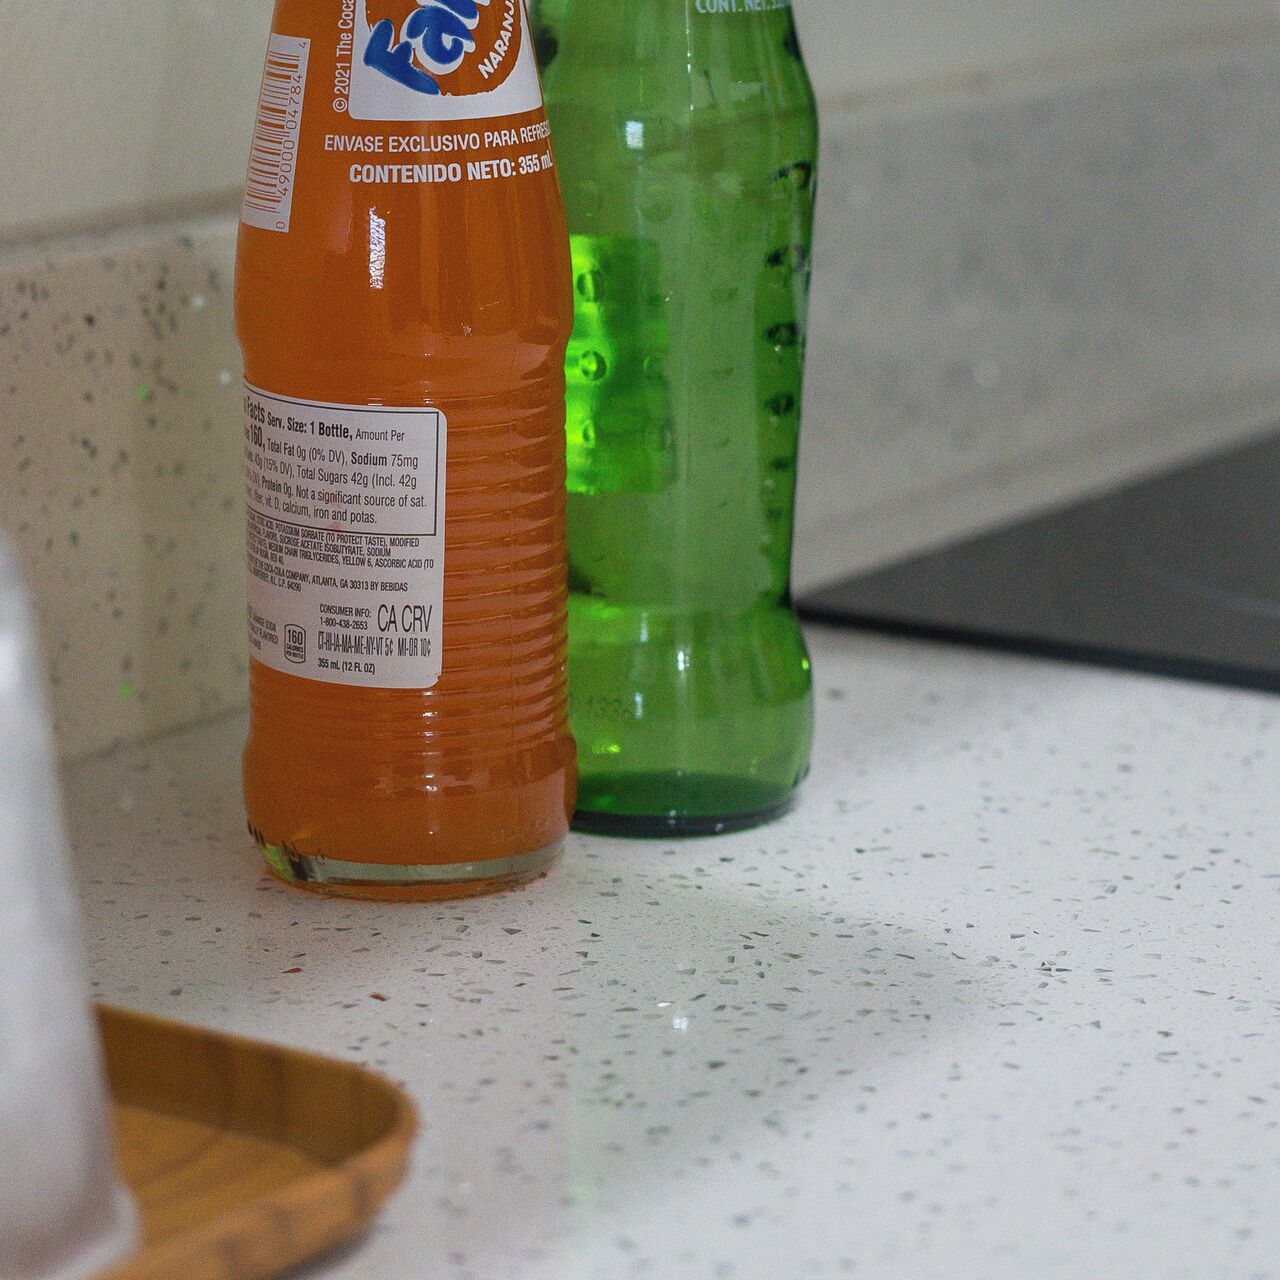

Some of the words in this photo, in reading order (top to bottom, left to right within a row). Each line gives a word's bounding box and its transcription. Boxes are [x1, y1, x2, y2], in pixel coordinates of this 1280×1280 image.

[299, 41, 308, 50] 4
[336, 32, 353, 58] The
[334, 61, 350, 95] 2021
[286, 73, 304, 130] 04784
[324, 134, 384, 152] ENVASE
[388, 133, 480, 153] EXCLUSIVO
[484, 128, 519, 148] PARA
[277, 140, 296, 197] 49000
[349, 162, 462, 184] CONTENIDO
[467, 158, 517, 181] NETO:
[518, 153, 540, 176] 355
[540, 149, 553, 170] mL
[268, 412, 284, 429] Serv.
[287, 417, 307, 433] Size:
[310, 421, 315, 435] 1
[318, 422, 353, 441] Bottle,
[355, 428, 388, 441] Amount
[391, 430, 405, 441] Per
[251, 423, 266, 452] 160,
[267, 438, 282, 454] Total
[284, 442, 295, 457] Fat
[297, 445, 306, 462] 0g
[309, 447, 326, 463] (0%
[329, 449, 347, 466] DV),
[351, 451, 387, 467] Sodium
[391, 454, 419, 470] 75mg
[264, 457, 278, 473] (15%
[280, 461, 295, 479] DV),
[297, 465, 316, 480] Total
[318, 468, 348, 485] Sugars
[351, 472, 368, 488] 42g
[372, 473, 395, 489] (Incl.
[399, 474, 417, 490] 42g
[262, 476, 282, 493] Protein
[283, 482, 294, 498] 0g.
[296, 485, 309, 499] Not
[310, 490, 316, 500] a
[318, 489, 361, 505] significant
[364, 495, 395, 507] source
[398, 494, 408, 507] of
[410, 495, 427, 508] sat.
[274, 497, 281, 512] D,
[282, 501, 311, 519] calcium,
[313, 505, 329, 519] iron
[331, 509, 348, 522] and
[350, 511, 377, 525] potas.
[275, 522, 300, 537] POTASSIUM
[300, 528, 325, 541] SORBATE
[325, 533, 336, 543] (TO
[337, 534, 364, 546] PROTECT
[365, 536, 388, 547] TASTE),
[389, 537, 420, 548] MODIFIED
[279, 534, 300, 548] SUCROSE
[300, 540, 323, 552] ACETATE
[324, 542, 365, 557] ISOBUTYRATE,
[366, 547, 391, 557] SODIUM
[284, 546, 299, 558] CHAIN
[299, 549, 341, 566] TRIGLYCERIDES,
[342, 555, 366, 566] YELLOW
[367, 557, 373, 568] 6,
[374, 559, 407, 569] ASCORBIC
[407, 559, 423, 569] ACID
[423, 559, 434, 570] (TO
[264, 561, 286, 578] COCA-COLA
[286, 569, 311, 585] COMPANY,
[312, 575, 339, 589] ATLANTA,
[340, 579, 349, 589] GA
[349, 580, 369, 590] 30313
[370, 581, 379, 591] BY
[380, 582, 408, 592] BEBIDAS
[320, 603, 354, 617] CONSUMER
[354, 607, 372, 618] INFO:
[320, 616, 368, 630] 1-800-438-2653
[377, 604, 398, 632] CA
[401, 604, 432, 632] CRV
[287, 629, 303, 645] 160
[384, 637, 394, 657] 5¢
[397, 637, 418, 657] MI-OR
[420, 637, 432, 657] 10¢
[317, 658, 329, 669] 355
[330, 660, 340, 670] mL
[341, 660, 353, 673] (12
[354, 662, 363, 673] FL
[363, 663, 376, 675] OZ)
